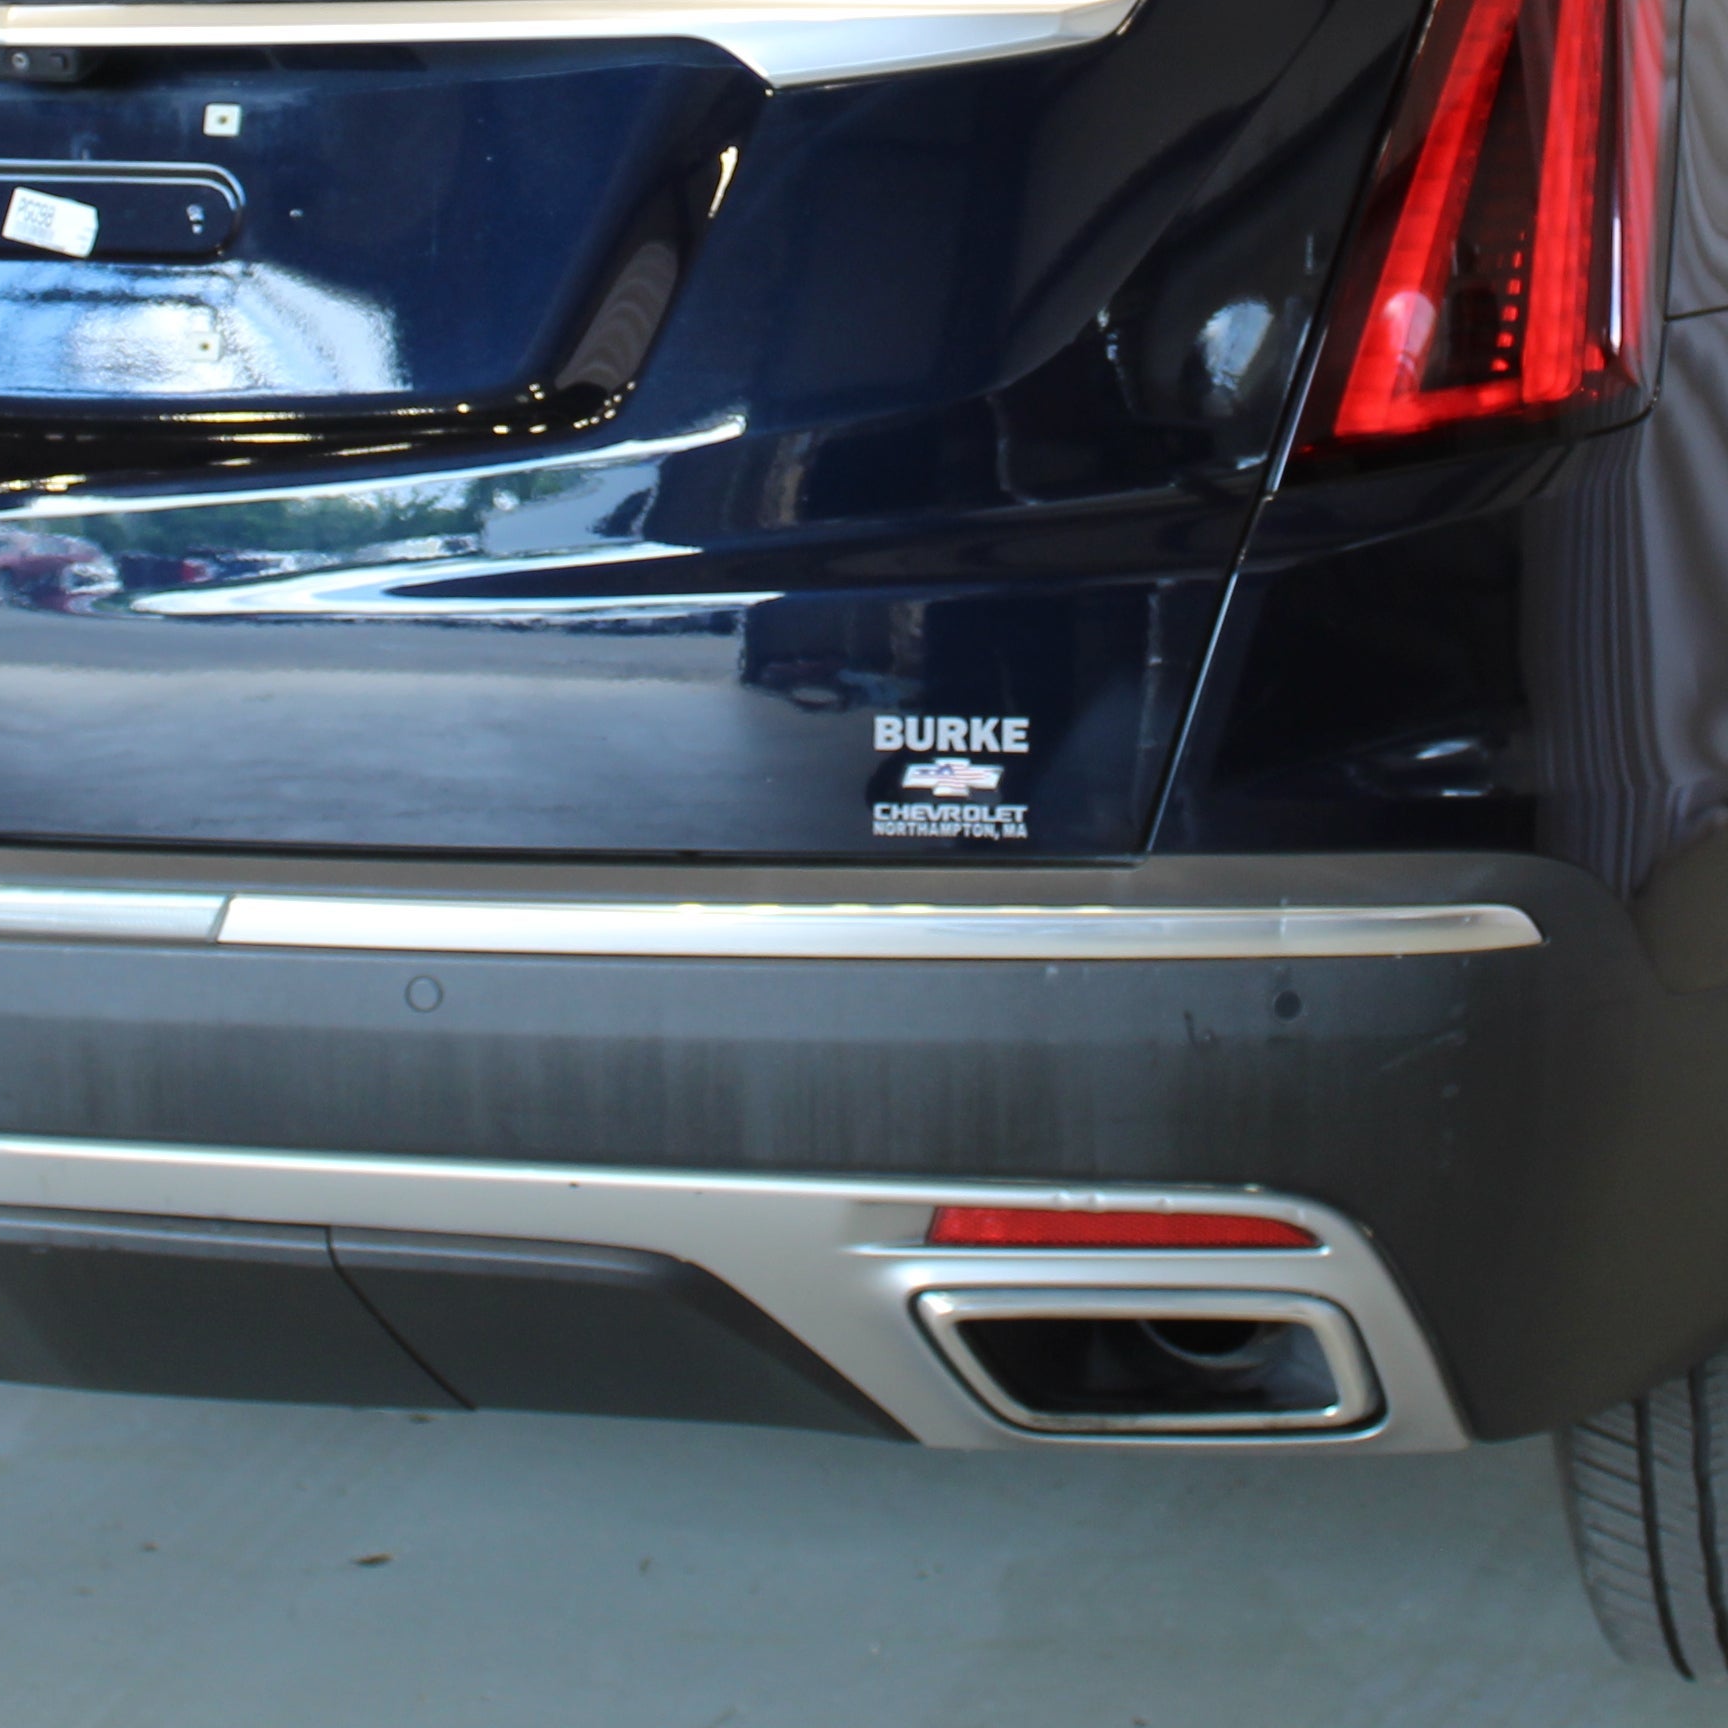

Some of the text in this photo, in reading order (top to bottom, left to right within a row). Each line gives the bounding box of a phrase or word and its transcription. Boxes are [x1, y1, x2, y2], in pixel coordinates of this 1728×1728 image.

[873, 715, 1030, 754] BURKE
[873, 802, 1029, 823] CHEVROLET
[873, 821, 1029, 841] NORTHAMPTON, MA
